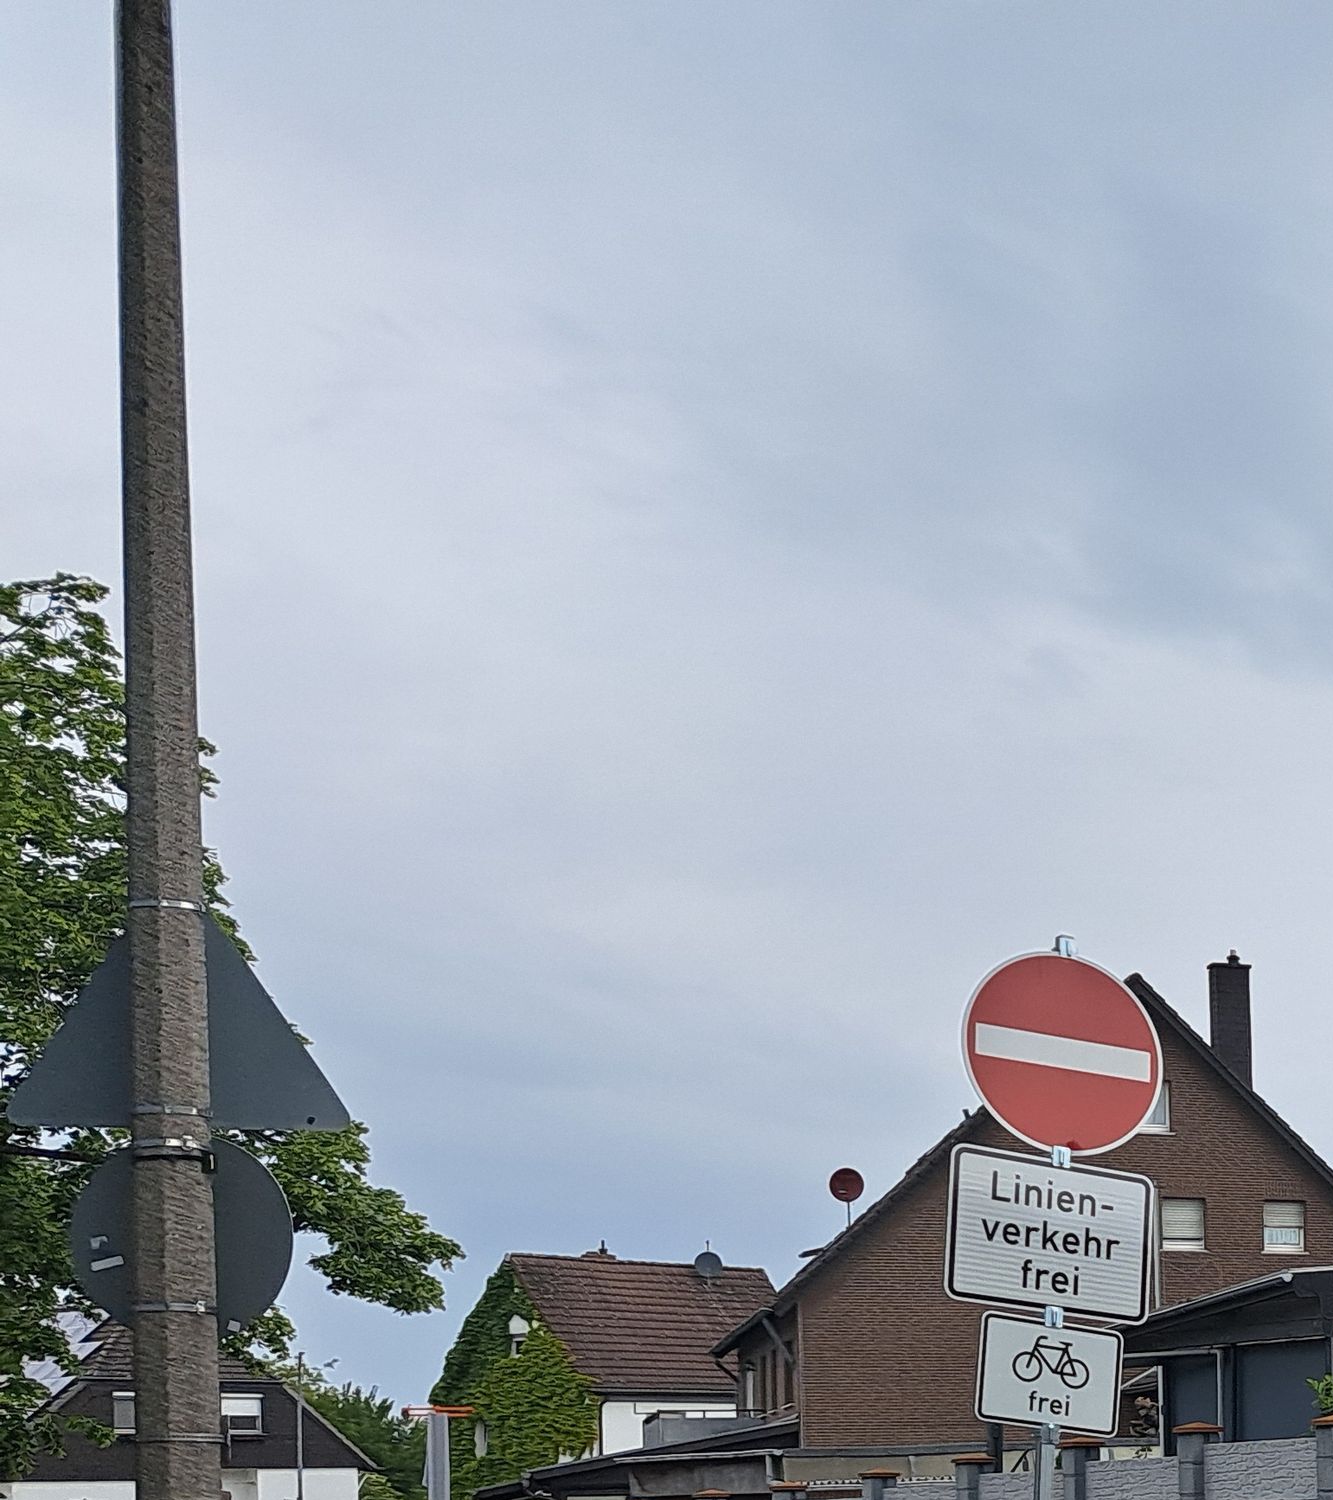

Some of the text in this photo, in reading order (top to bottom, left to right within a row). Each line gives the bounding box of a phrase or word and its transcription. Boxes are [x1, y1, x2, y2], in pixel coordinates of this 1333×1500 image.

[990, 1170, 1114, 1217] Linien-
[981, 1218, 1121, 1260] verkehr
[1021, 1259, 1080, 1295] frei
[1029, 1390, 1071, 1417] frei
